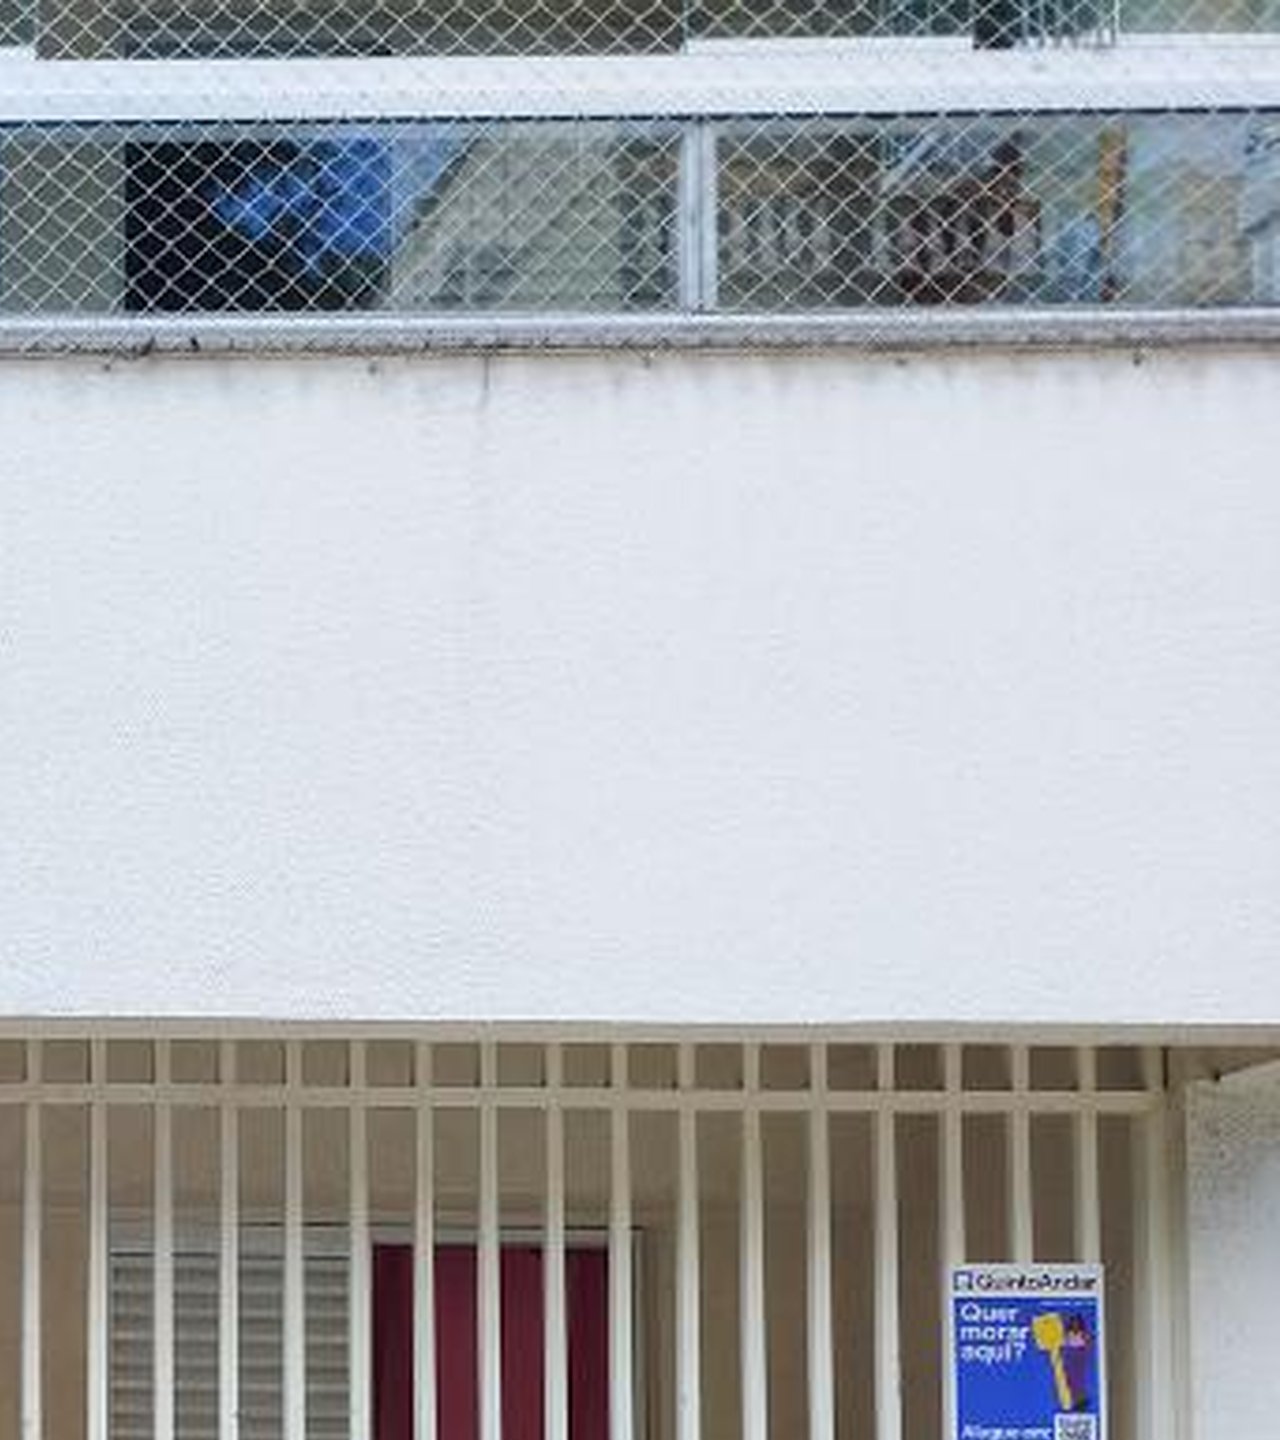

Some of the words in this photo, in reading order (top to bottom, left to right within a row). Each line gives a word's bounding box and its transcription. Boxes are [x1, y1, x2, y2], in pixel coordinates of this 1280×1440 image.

[960, 1302, 1019, 1323] Quer
[960, 1325, 1030, 1341] morar
[960, 1342, 1027, 1365] aqui?
